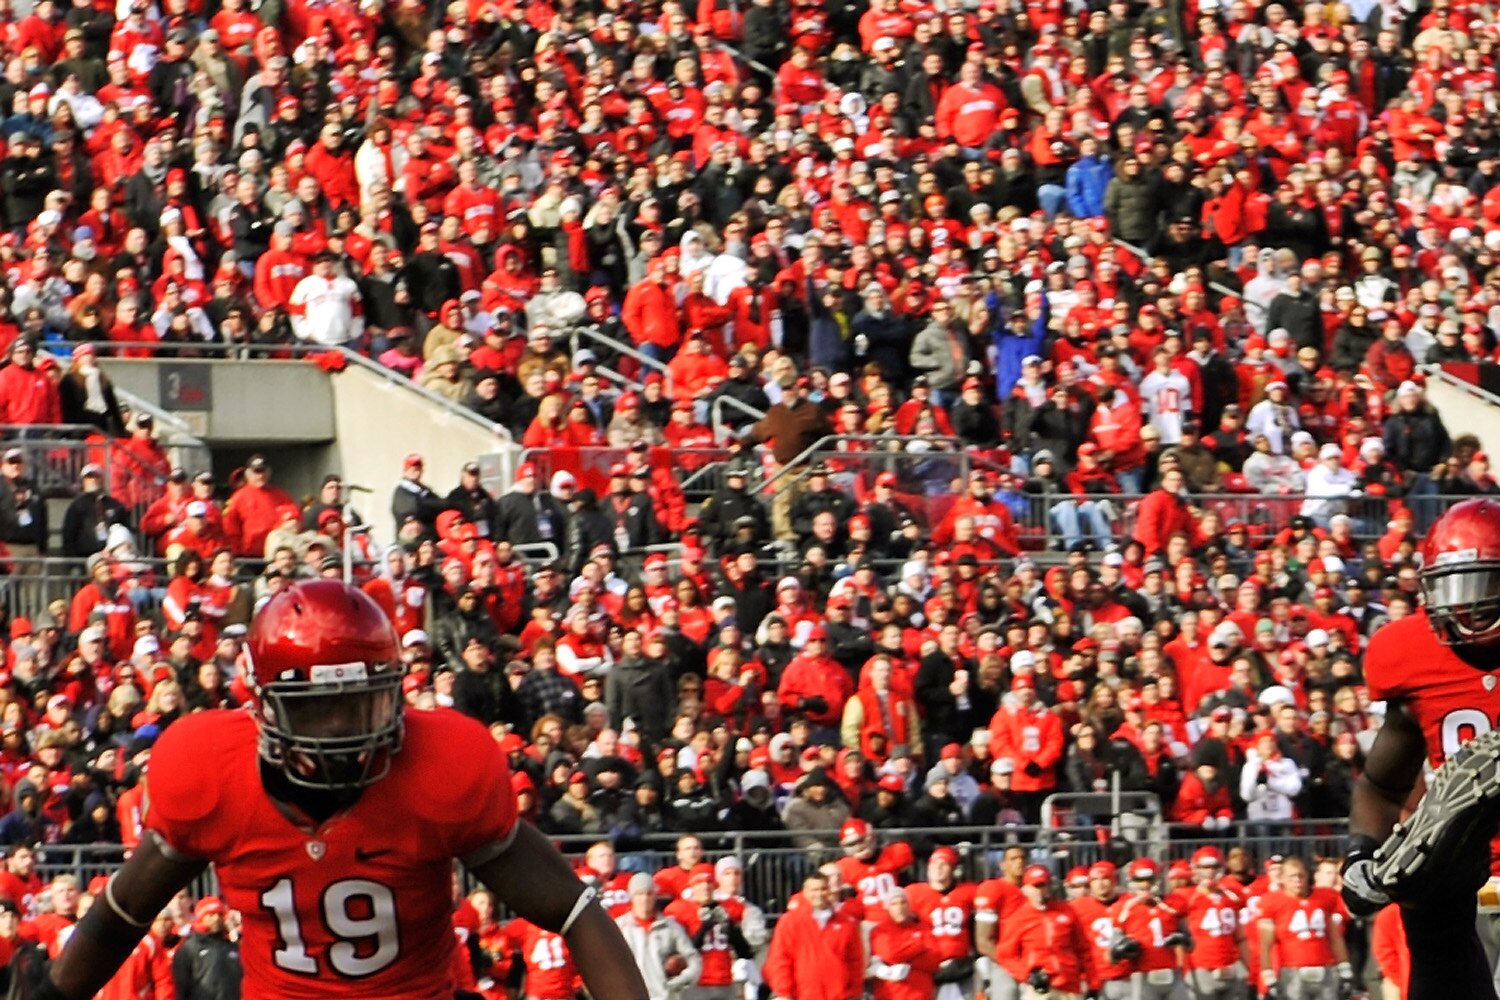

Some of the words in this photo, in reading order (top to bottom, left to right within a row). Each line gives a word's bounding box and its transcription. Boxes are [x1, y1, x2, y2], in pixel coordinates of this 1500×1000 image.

[262, 878, 400, 976] 19
[1289, 908, 1327, 941] 44
[531, 936, 566, 970] 41
